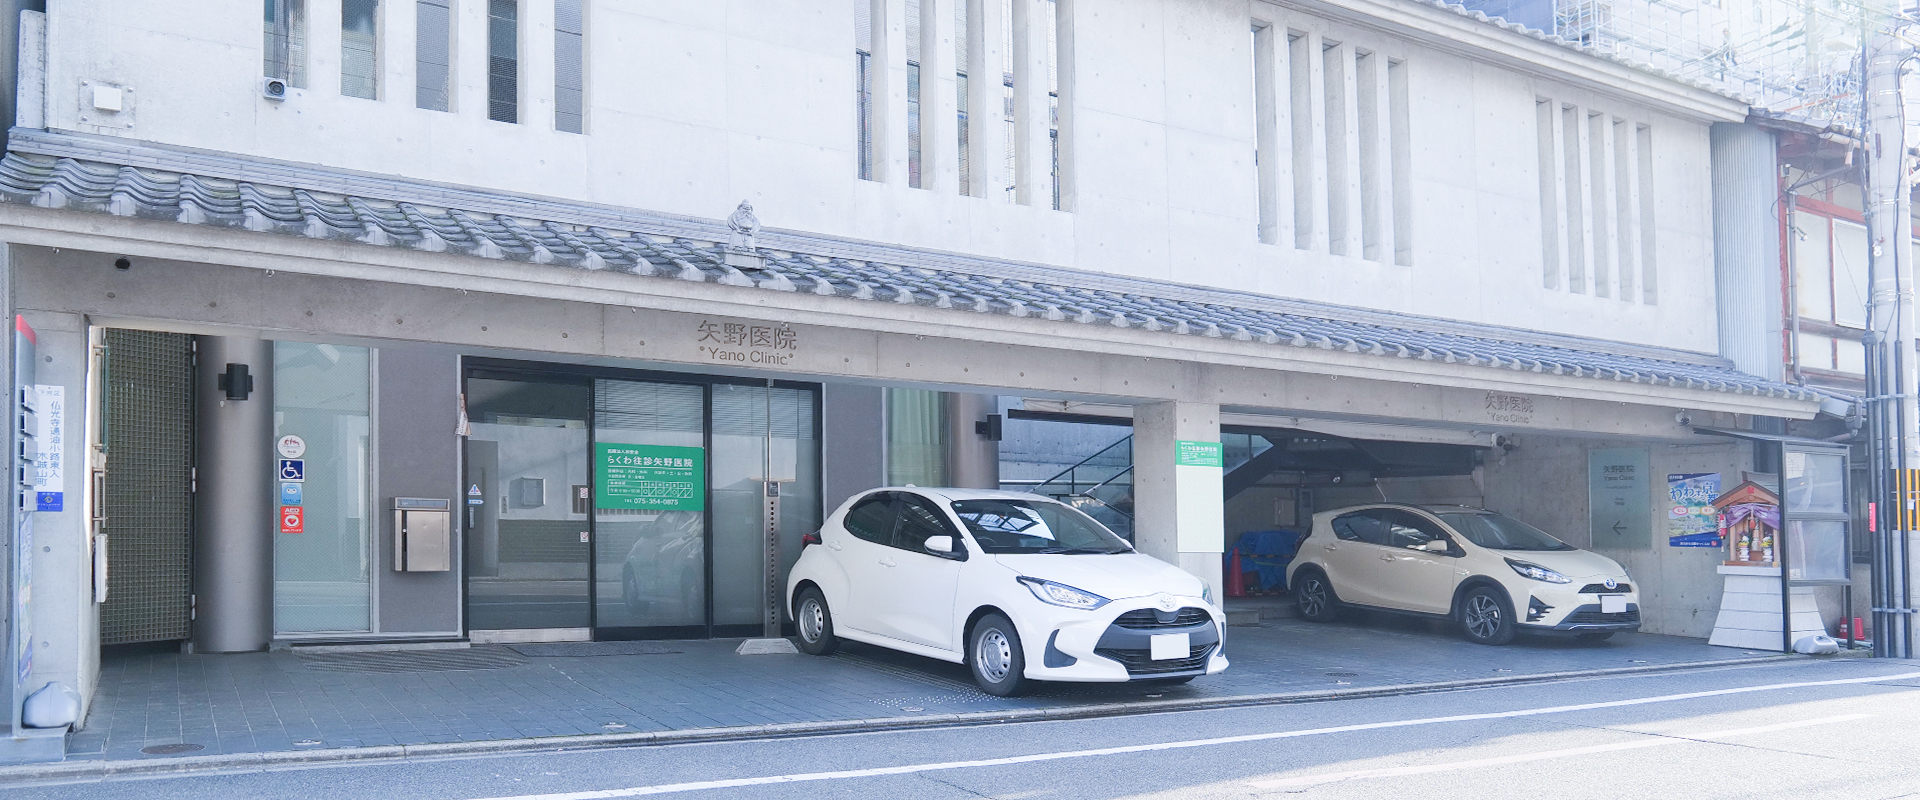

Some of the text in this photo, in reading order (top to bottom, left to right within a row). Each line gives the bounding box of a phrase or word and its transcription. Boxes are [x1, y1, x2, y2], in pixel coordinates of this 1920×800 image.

[697, 319, 797, 350] 矢野医院
[708, 346, 788, 366] Yano Clinic
[1485, 392, 1534, 413] 矢野医院
[1491, 412, 1530, 424] Yano Clinic
[49, 400, 61, 478] 仏光寺通油小路東入
[608, 456, 693, 467] らくわ往診矢野医院
